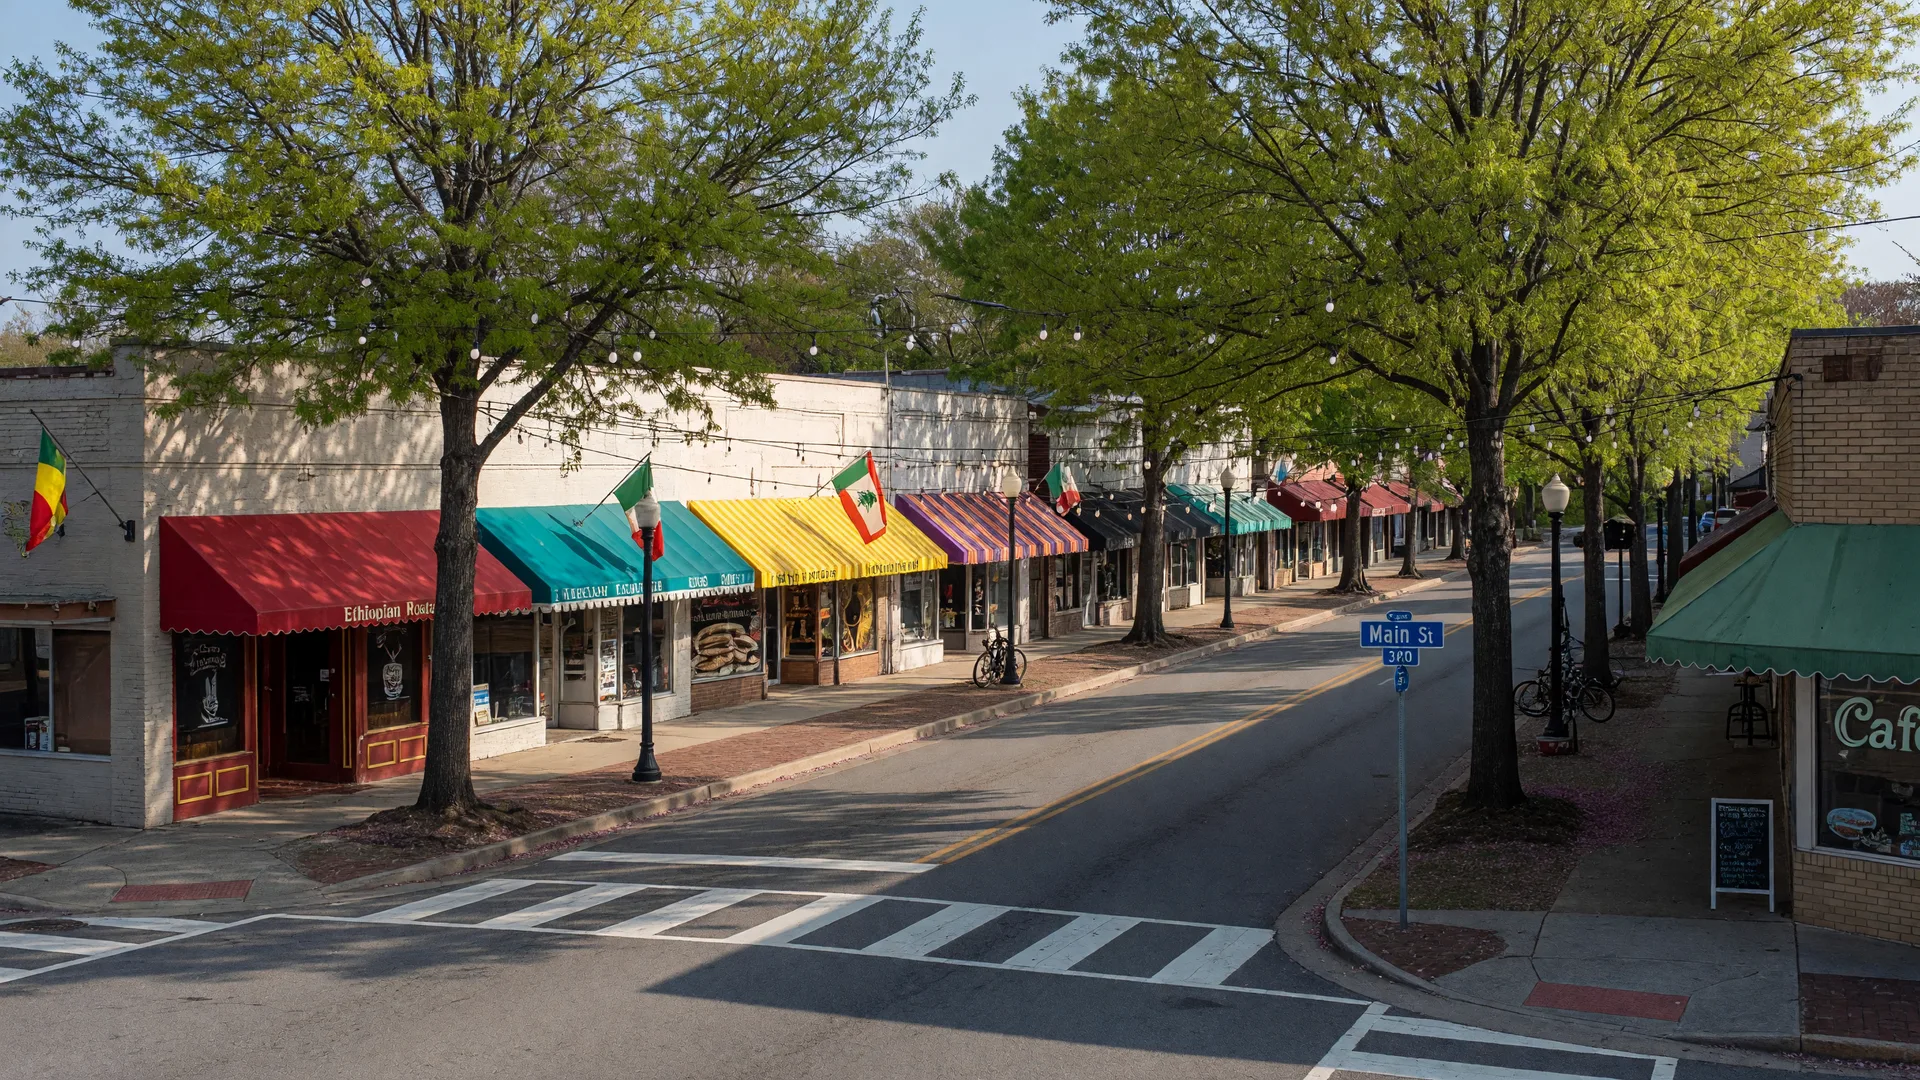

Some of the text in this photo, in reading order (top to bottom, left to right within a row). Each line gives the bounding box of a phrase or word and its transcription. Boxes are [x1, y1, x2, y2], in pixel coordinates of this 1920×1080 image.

[344, 604, 401, 622] Ethiopian
[1369, 624, 1434, 644] Main St
[1834, 696, 1920, 752] Caf
